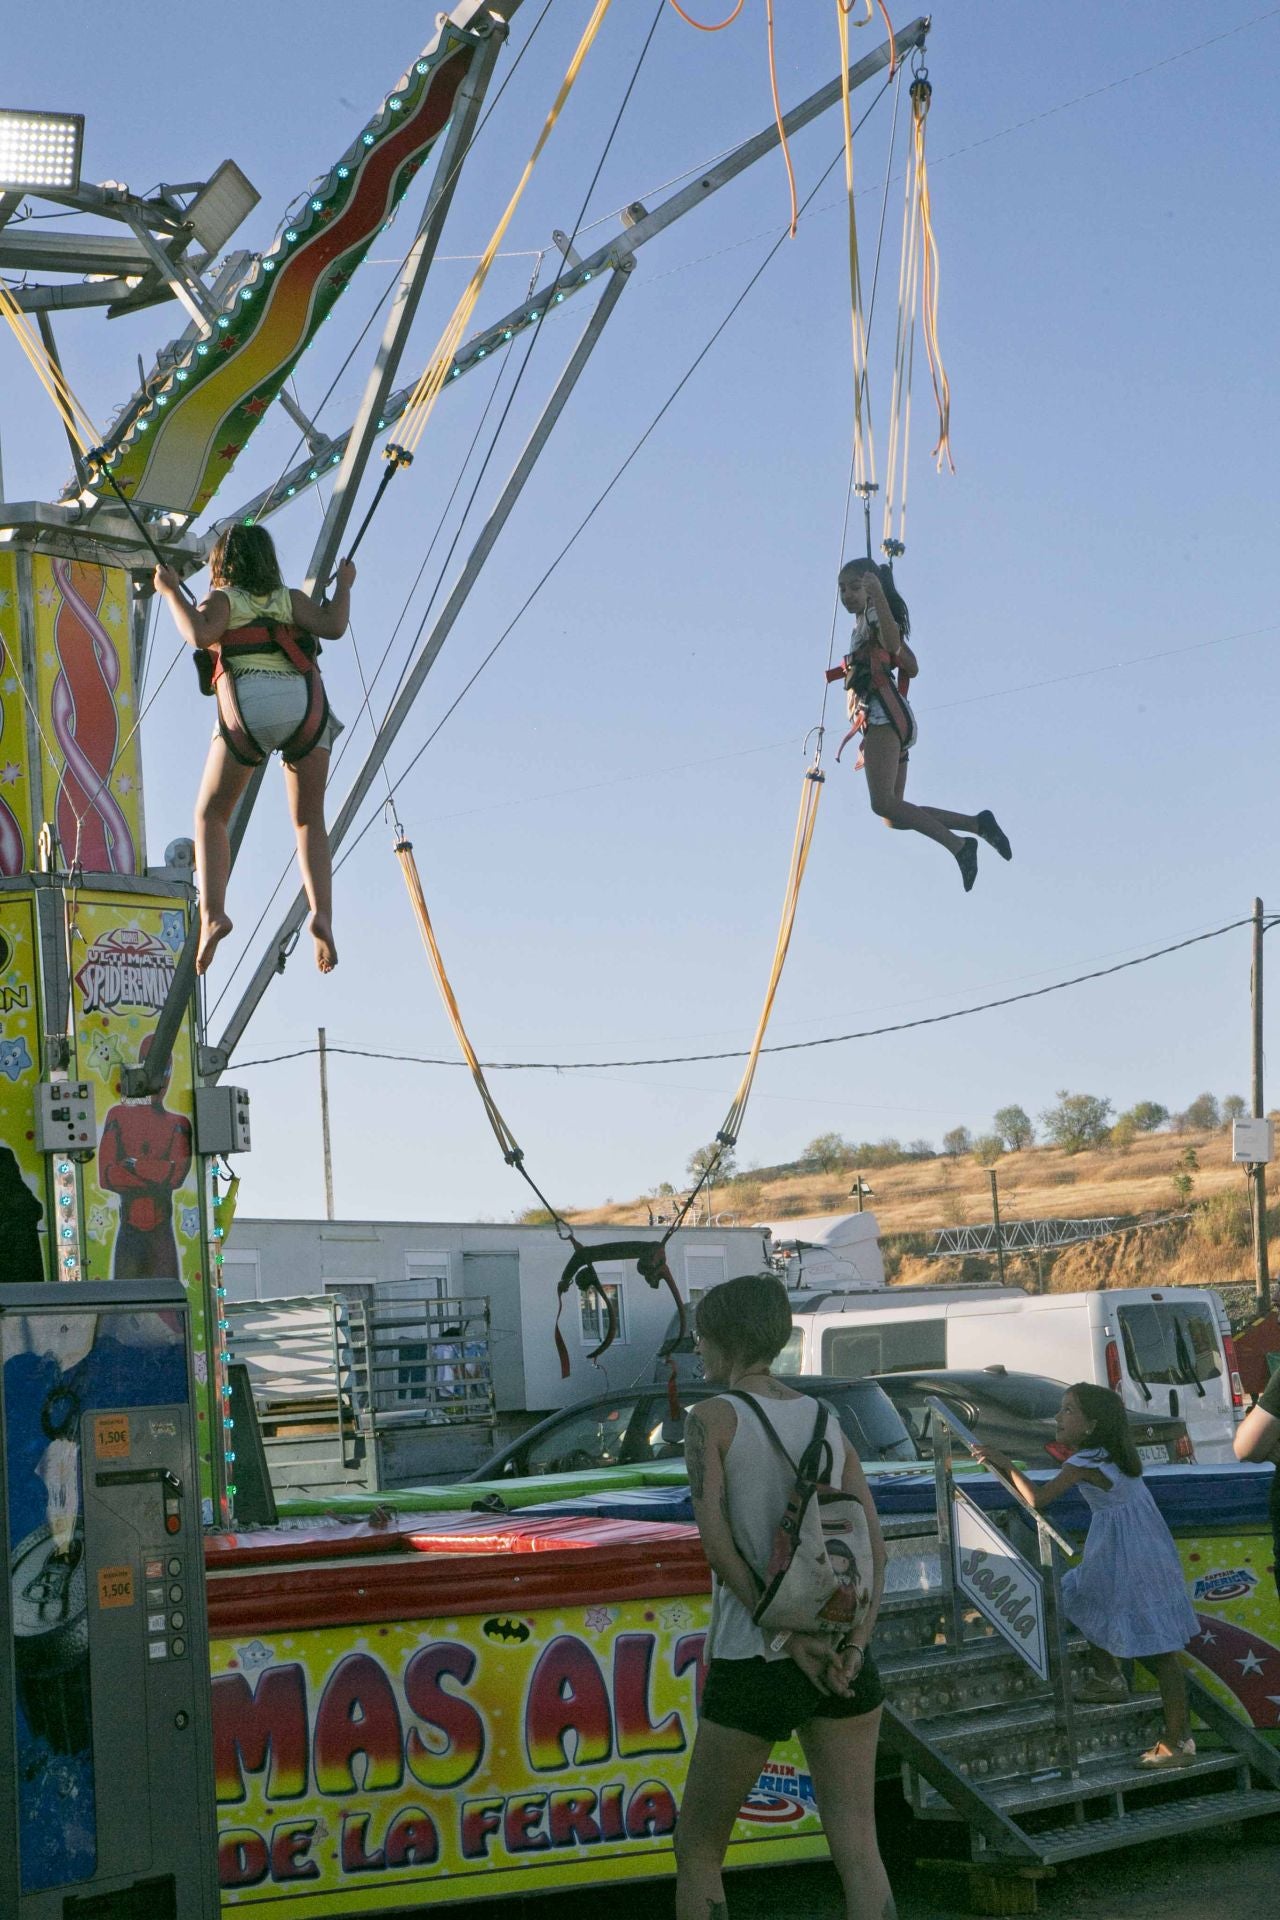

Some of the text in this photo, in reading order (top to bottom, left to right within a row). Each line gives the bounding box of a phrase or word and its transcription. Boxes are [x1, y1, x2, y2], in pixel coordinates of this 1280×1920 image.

[87, 950, 175, 966] ULTIMATE
[99, 1430, 128, 1445] 1,50€
[102, 1582, 131, 1599] 1,50€
[962, 1548, 1036, 1639] Salida
[211, 1641, 484, 1804] MAS
[218, 1779, 677, 1890] DE LA FERIA
